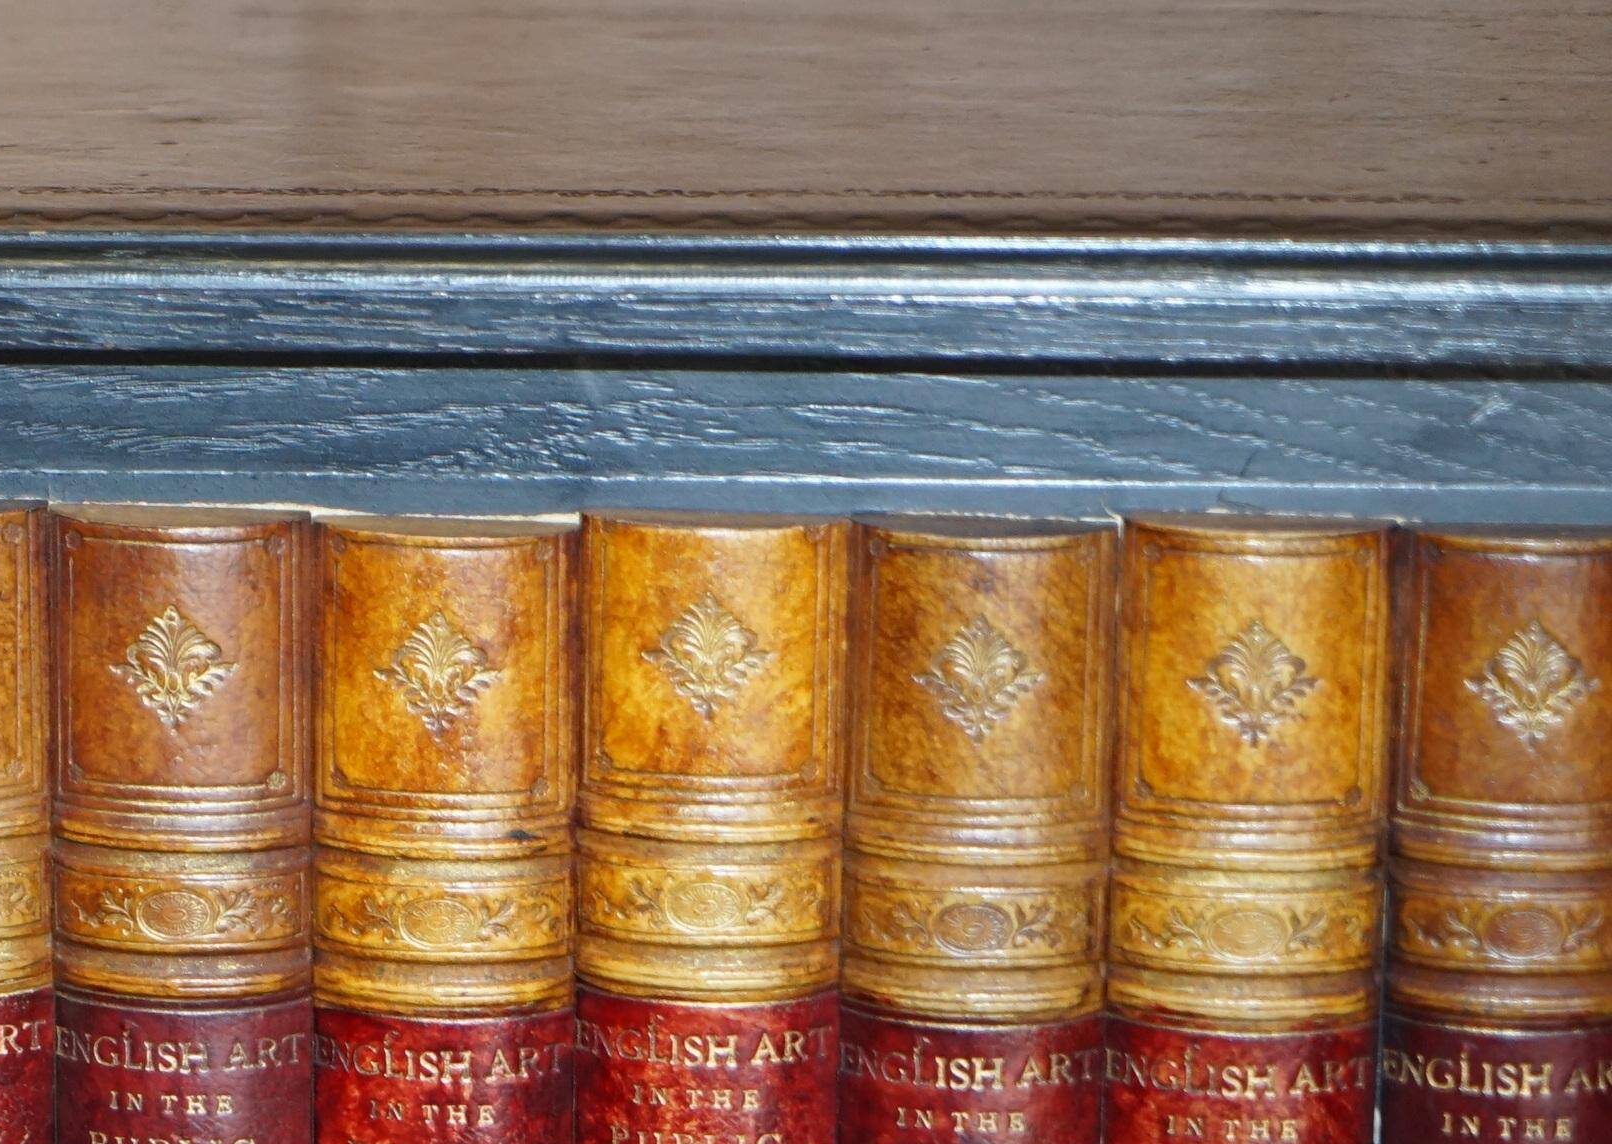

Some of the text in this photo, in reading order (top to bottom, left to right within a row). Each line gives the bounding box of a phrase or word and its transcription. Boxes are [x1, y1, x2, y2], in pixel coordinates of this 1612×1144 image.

[56, 1025, 305, 1074] ENGLISH ART
[313, 1033, 566, 1084] ENGLISH ART
[574, 1018, 832, 1068] ENGLISH ART
[839, 1042, 1098, 1091] ENGLISH ART
[1103, 1048, 1372, 1099] ENGLISH ART
[1383, 1049, 1554, 1097] ENGLISH
[109, 1091, 233, 1115] IN THE
[370, 1101, 496, 1126] IN THE
[633, 1085, 759, 1112] IN THE
[896, 1107, 1025, 1134] IN THE
[1167, 1115, 1297, 1141] IN THE
[1442, 1113, 1572, 1140] IN THE
